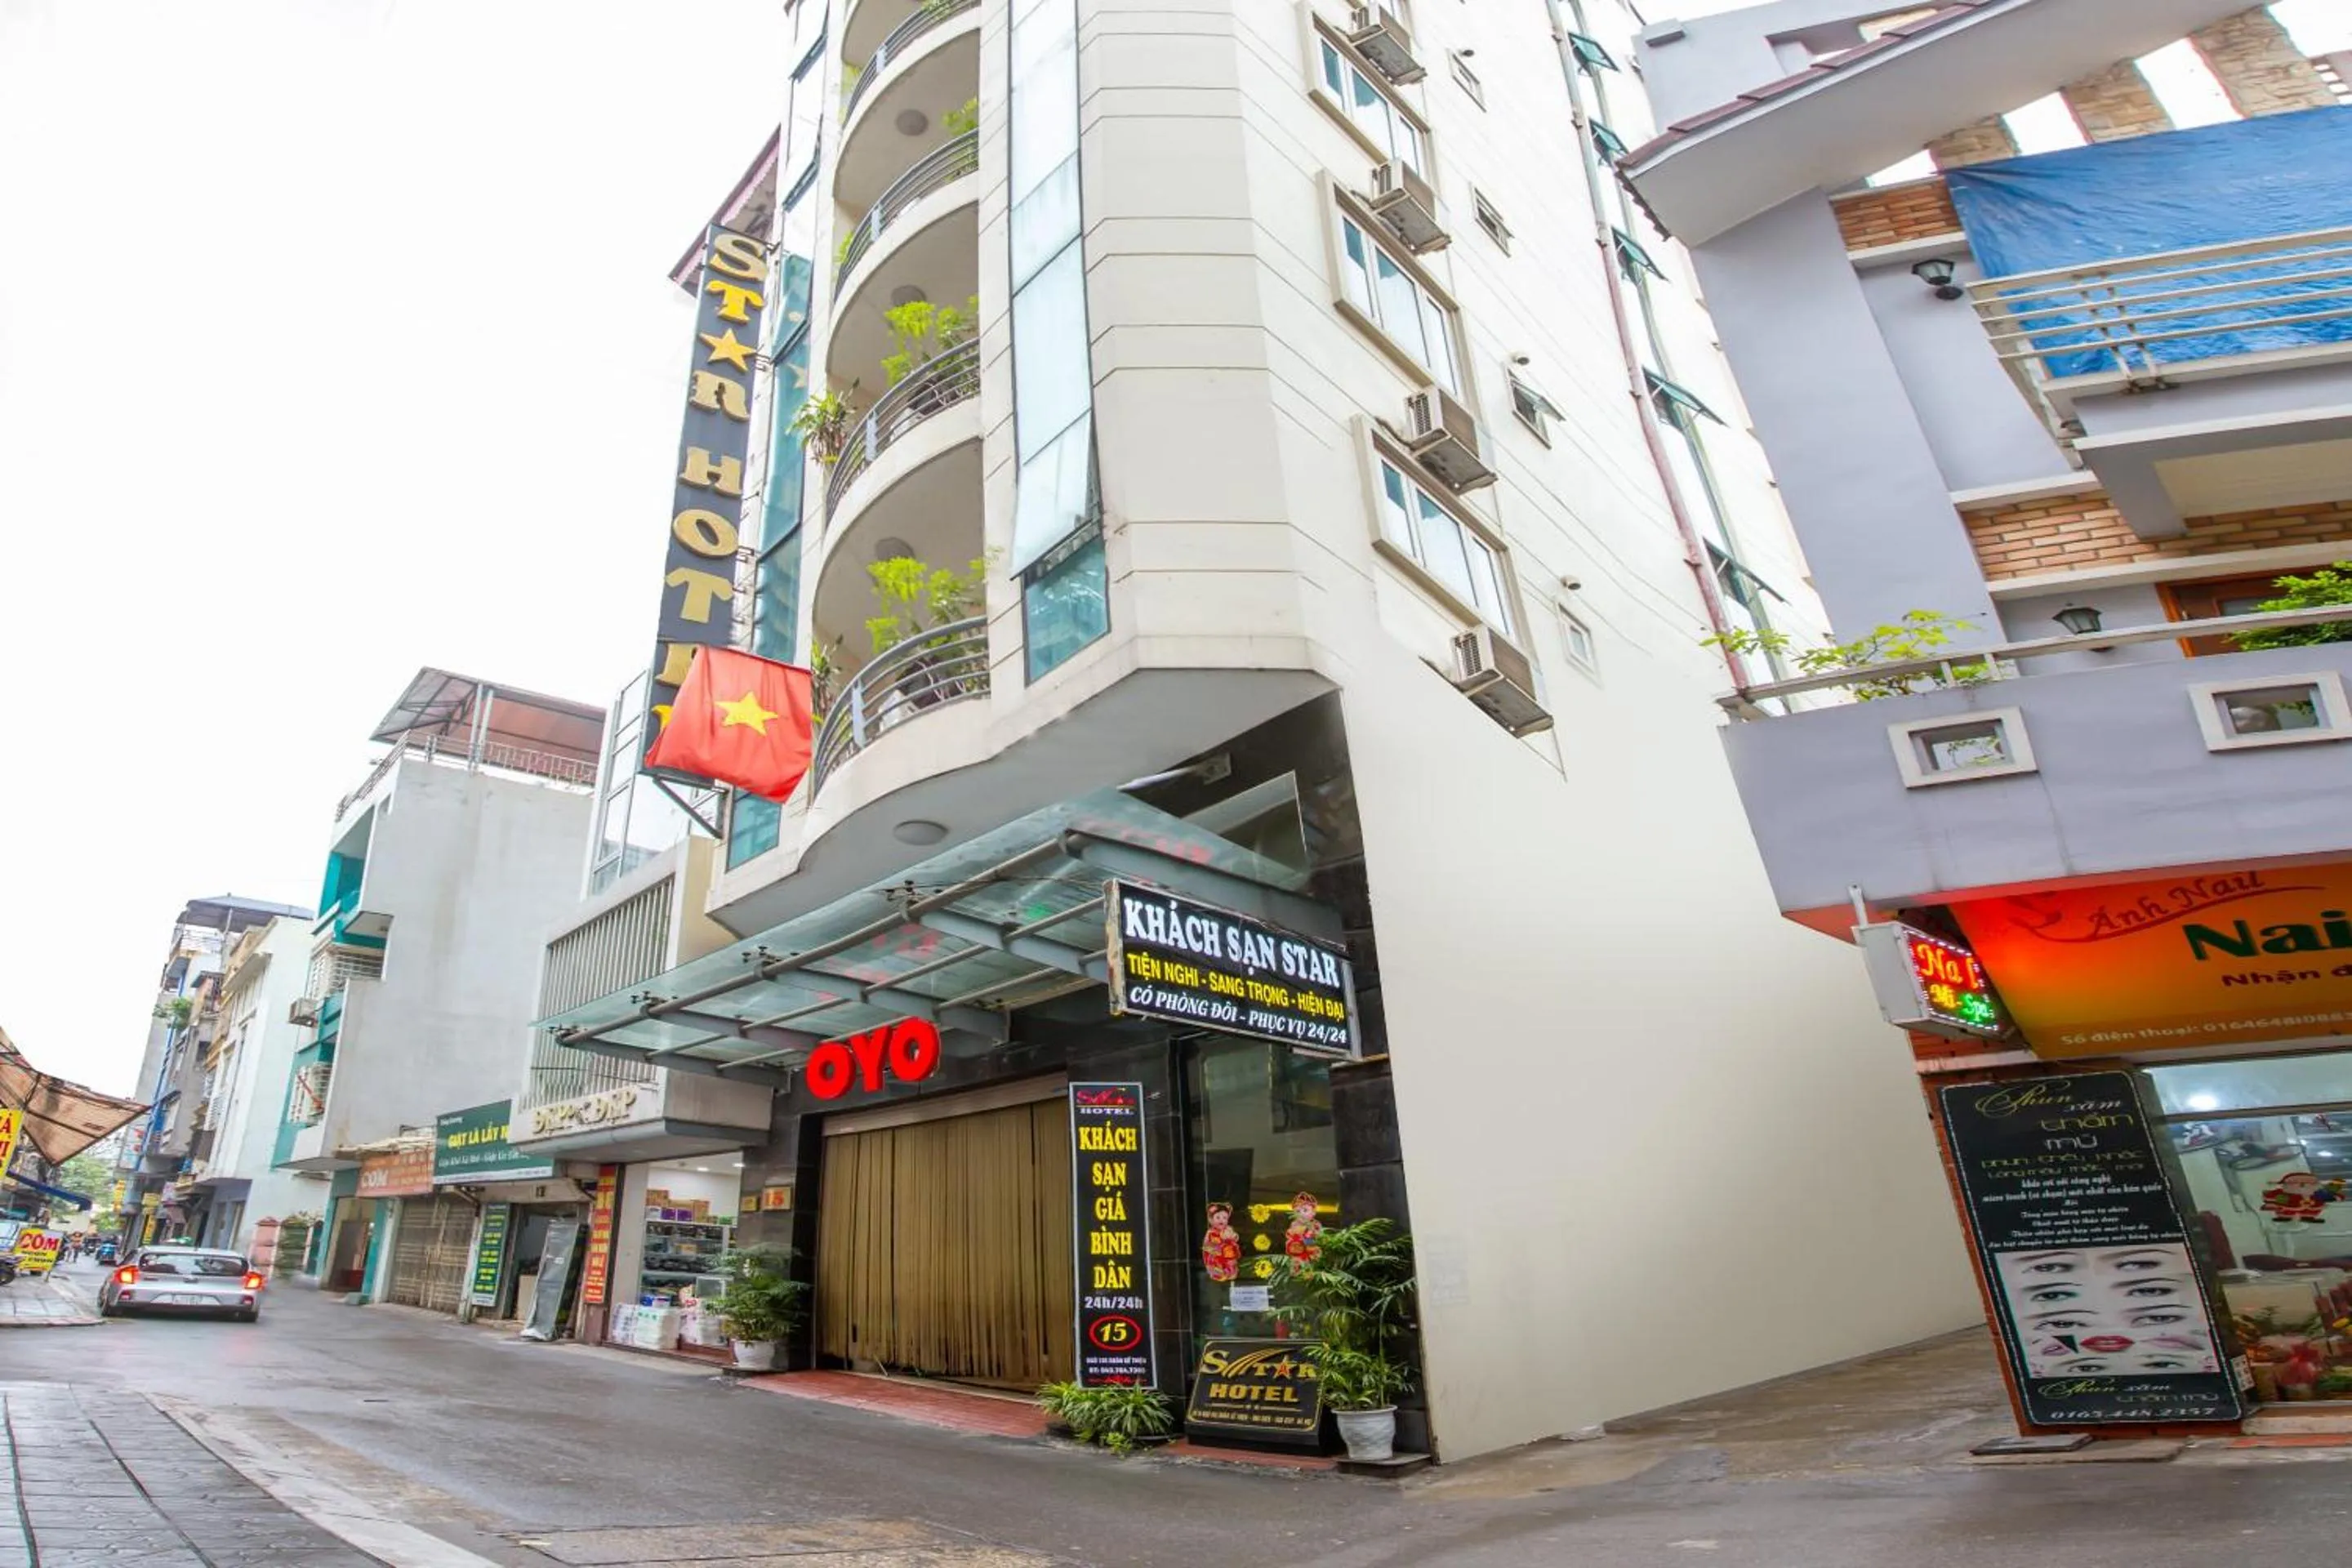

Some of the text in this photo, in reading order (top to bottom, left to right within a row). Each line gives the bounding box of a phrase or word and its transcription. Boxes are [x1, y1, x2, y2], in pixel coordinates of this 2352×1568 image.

[2168, 870, 2265, 908] Nail
[1124, 898, 1340, 989] KHÁCH SẠN STAR
[1127, 951, 1161, 981] TIỆN
[1164, 961, 1199, 987] NGHI
[1209, 971, 1245, 997] SANG
[1246, 981, 1290, 1007] TRỌNG
[1297, 991, 1325, 1017] HIỆN
[1325, 999, 1345, 1022] ĐẠI
[2221, 968, 2321, 987] Nhận
[1129, 984, 1154, 1005] CÓ
[1155, 991, 1209, 1018] PHÒNG
[1211, 1001, 1239, 1022] ĐÔI
[1249, 1009, 1286, 1034] PHỤC
[1287, 1018, 1306, 1039] VỤ
[1307, 1022, 1348, 1044] 24/24
[2091, 1030, 2135, 1044] điện
[804, 1015, 941, 1100] OYO
[1079, 1107, 1134, 1116] HOTEL
[1079, 1120, 1137, 1152] KHÁCH
[1092, 1161, 1126, 1192] SẠN
[1095, 1191, 1127, 1221] GIÁ
[1090, 1225, 1133, 1255] BÌNH
[1094, 1259, 1131, 1289] DÂN
[1084, 1296, 1143, 1309] 24h/24h
[1099, 1322, 1127, 1342] 15
[1209, 1383, 1300, 1402] HOTEL
